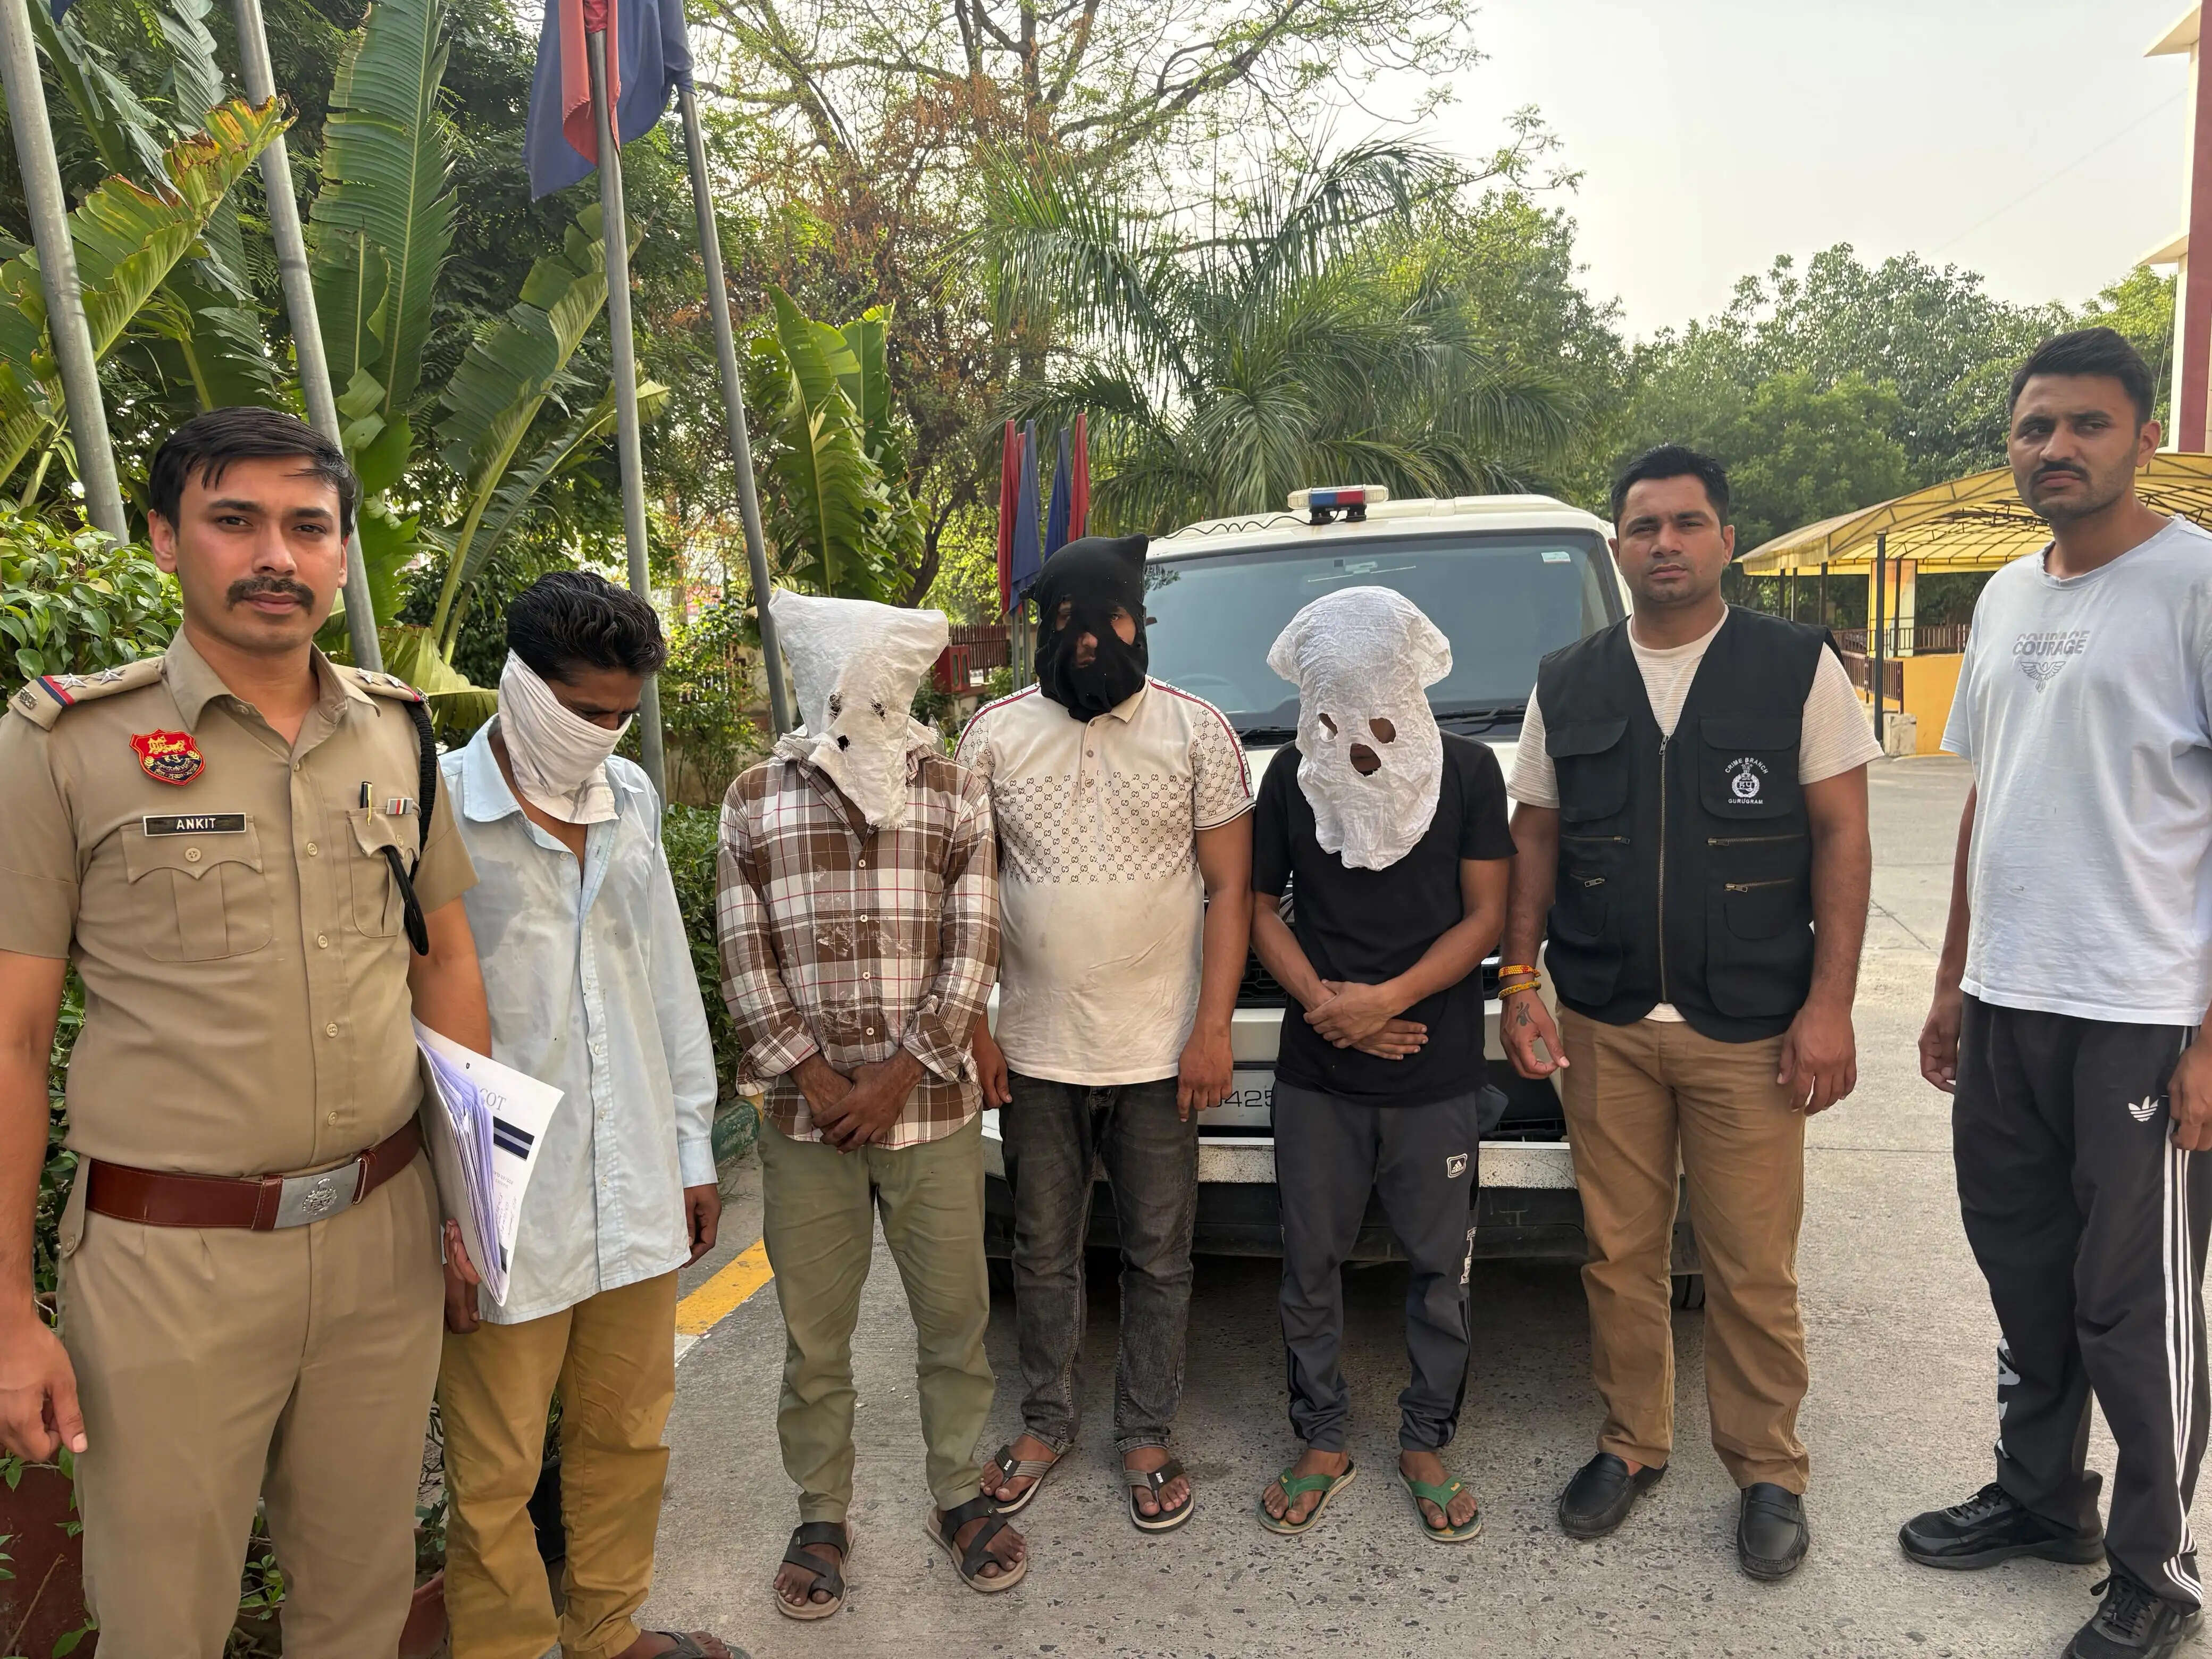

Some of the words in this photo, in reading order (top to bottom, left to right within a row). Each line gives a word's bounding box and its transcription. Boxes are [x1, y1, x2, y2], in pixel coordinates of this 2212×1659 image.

[2012, 639, 2087, 656] COURAGE
[1725, 758, 1743, 773] CRIME
[1745, 757, 1769, 774] BRANCH
[176, 818, 216, 830] ANKIT
